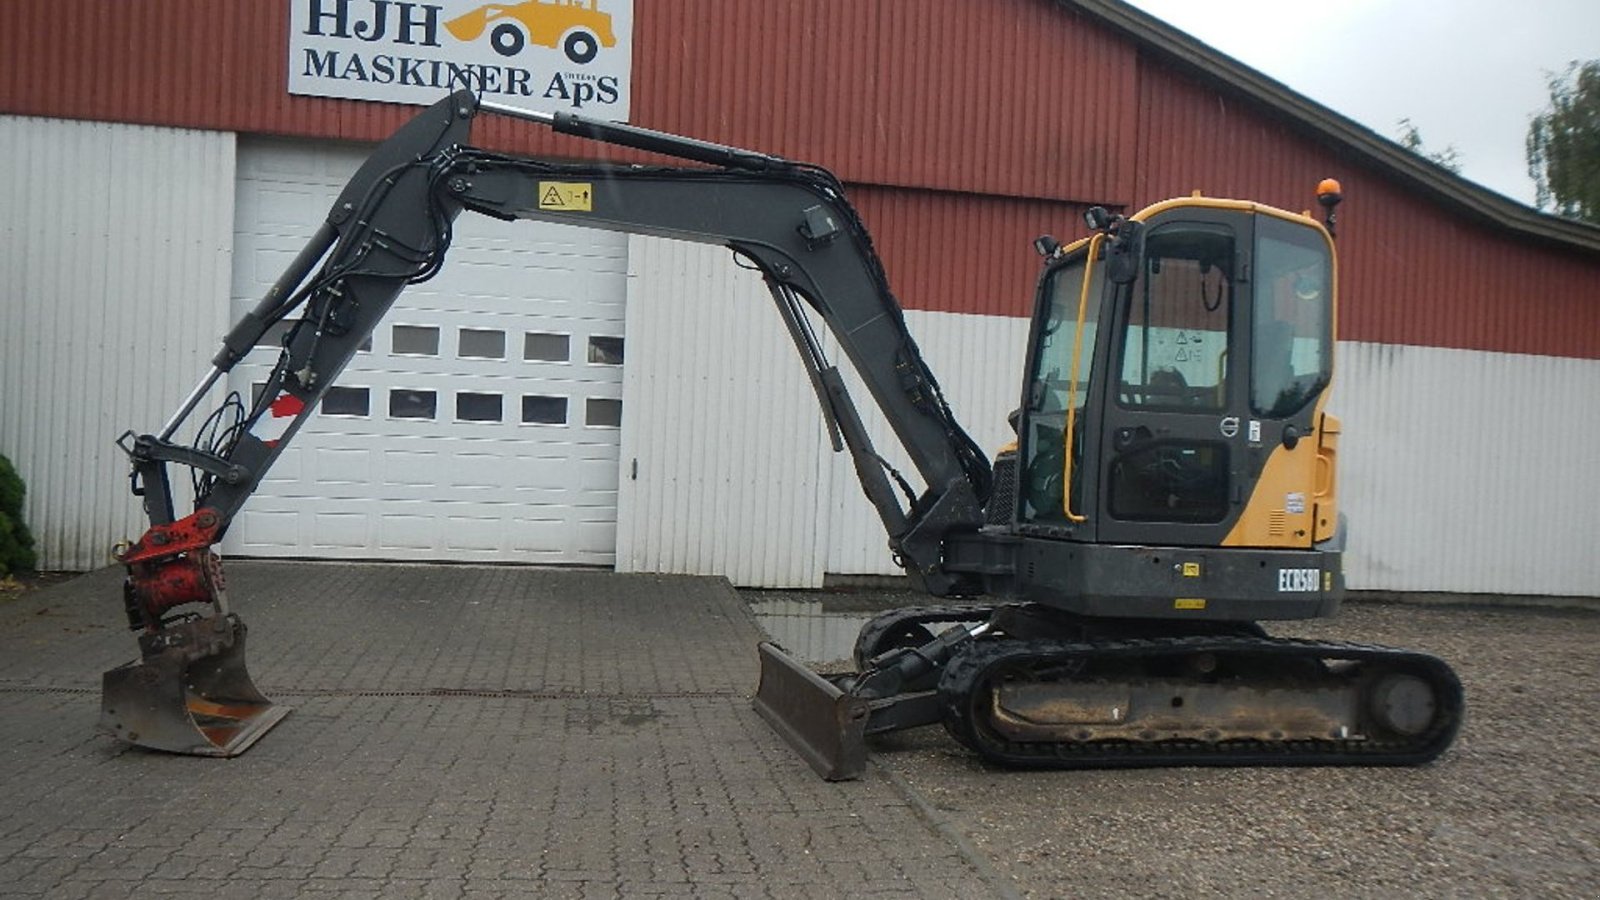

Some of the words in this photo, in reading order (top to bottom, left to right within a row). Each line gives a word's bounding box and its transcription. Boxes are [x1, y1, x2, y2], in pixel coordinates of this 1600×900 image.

[303, 0, 443, 47] HJH
[302, 48, 534, 96] MASKINER
[543, 72, 618, 107] ApS
